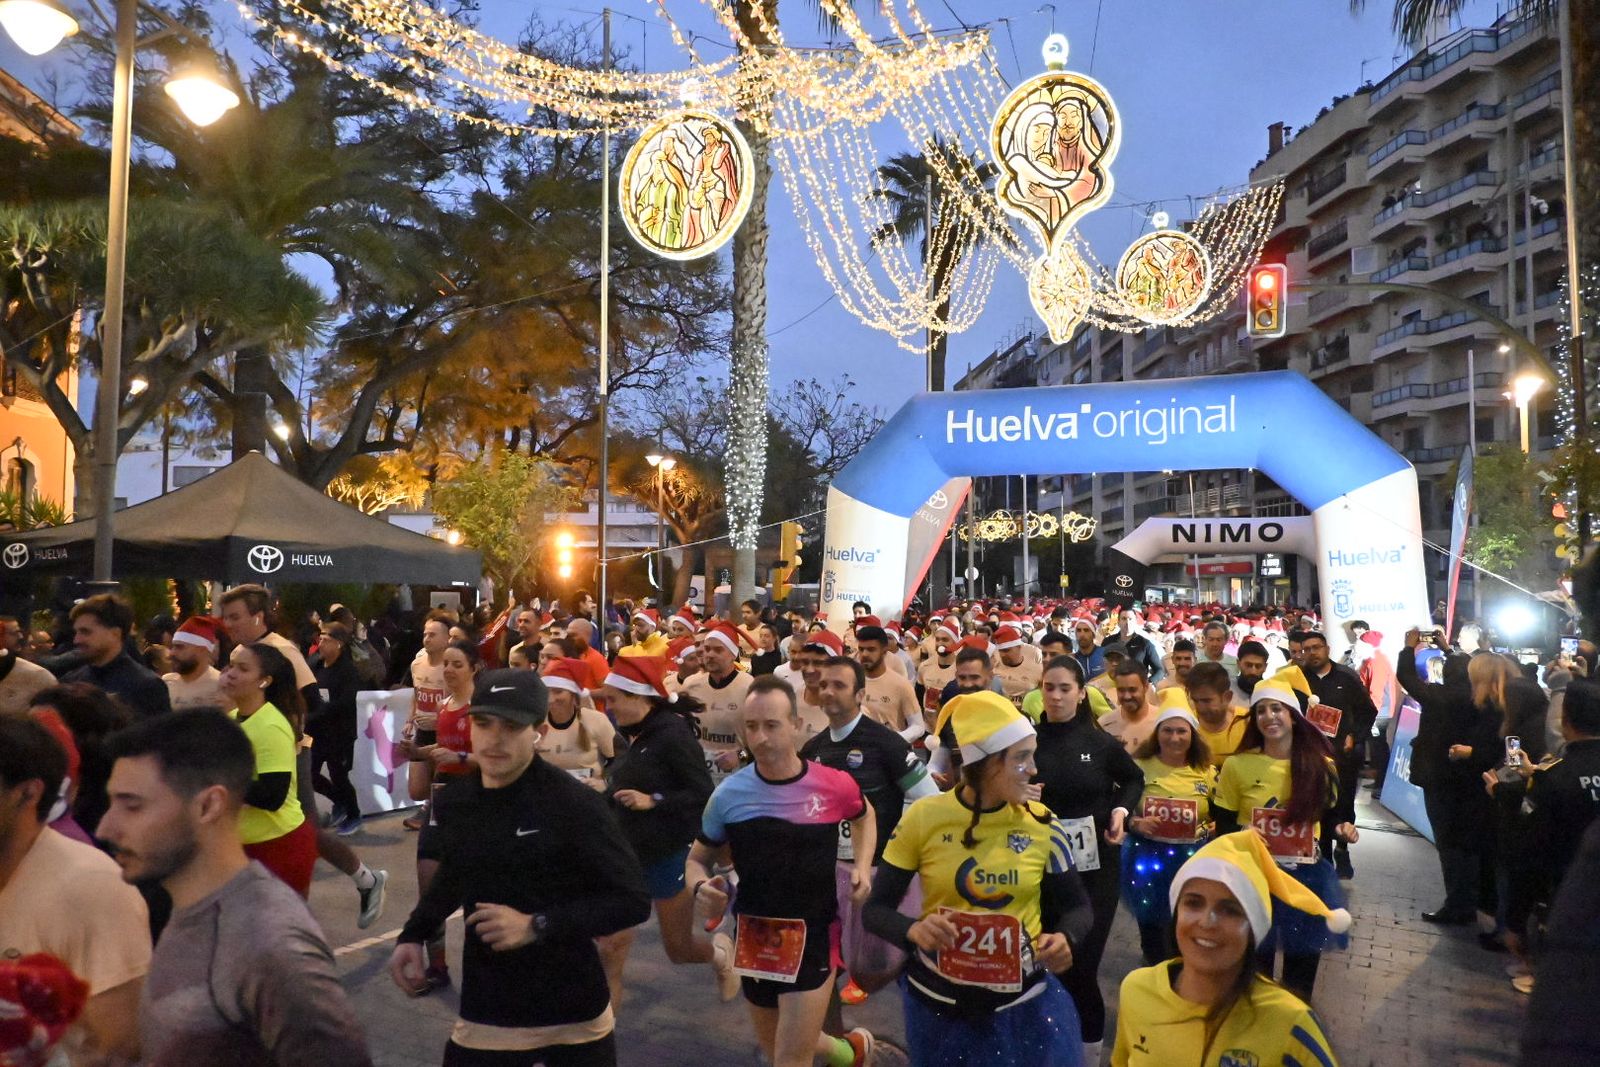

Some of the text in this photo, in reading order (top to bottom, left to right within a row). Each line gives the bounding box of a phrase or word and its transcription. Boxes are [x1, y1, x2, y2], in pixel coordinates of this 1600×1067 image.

[946, 395, 1236, 445] Huelva original
[915, 508, 941, 528] UELVA
[1172, 522, 1284, 543] NIMO
[33, 548, 68, 560] HUELVA
[291, 554, 334, 566] HUELVA
[826, 546, 875, 563] Huelva
[1328, 546, 1402, 567] Huelva
[837, 592, 871, 603] HUELVA
[1359, 602, 1405, 613] HUELVA
[417, 691, 442, 703] 2010
[1147, 806, 1195, 825] 1939
[974, 869, 1019, 886] Snell
[952, 926, 1014, 955] 241
